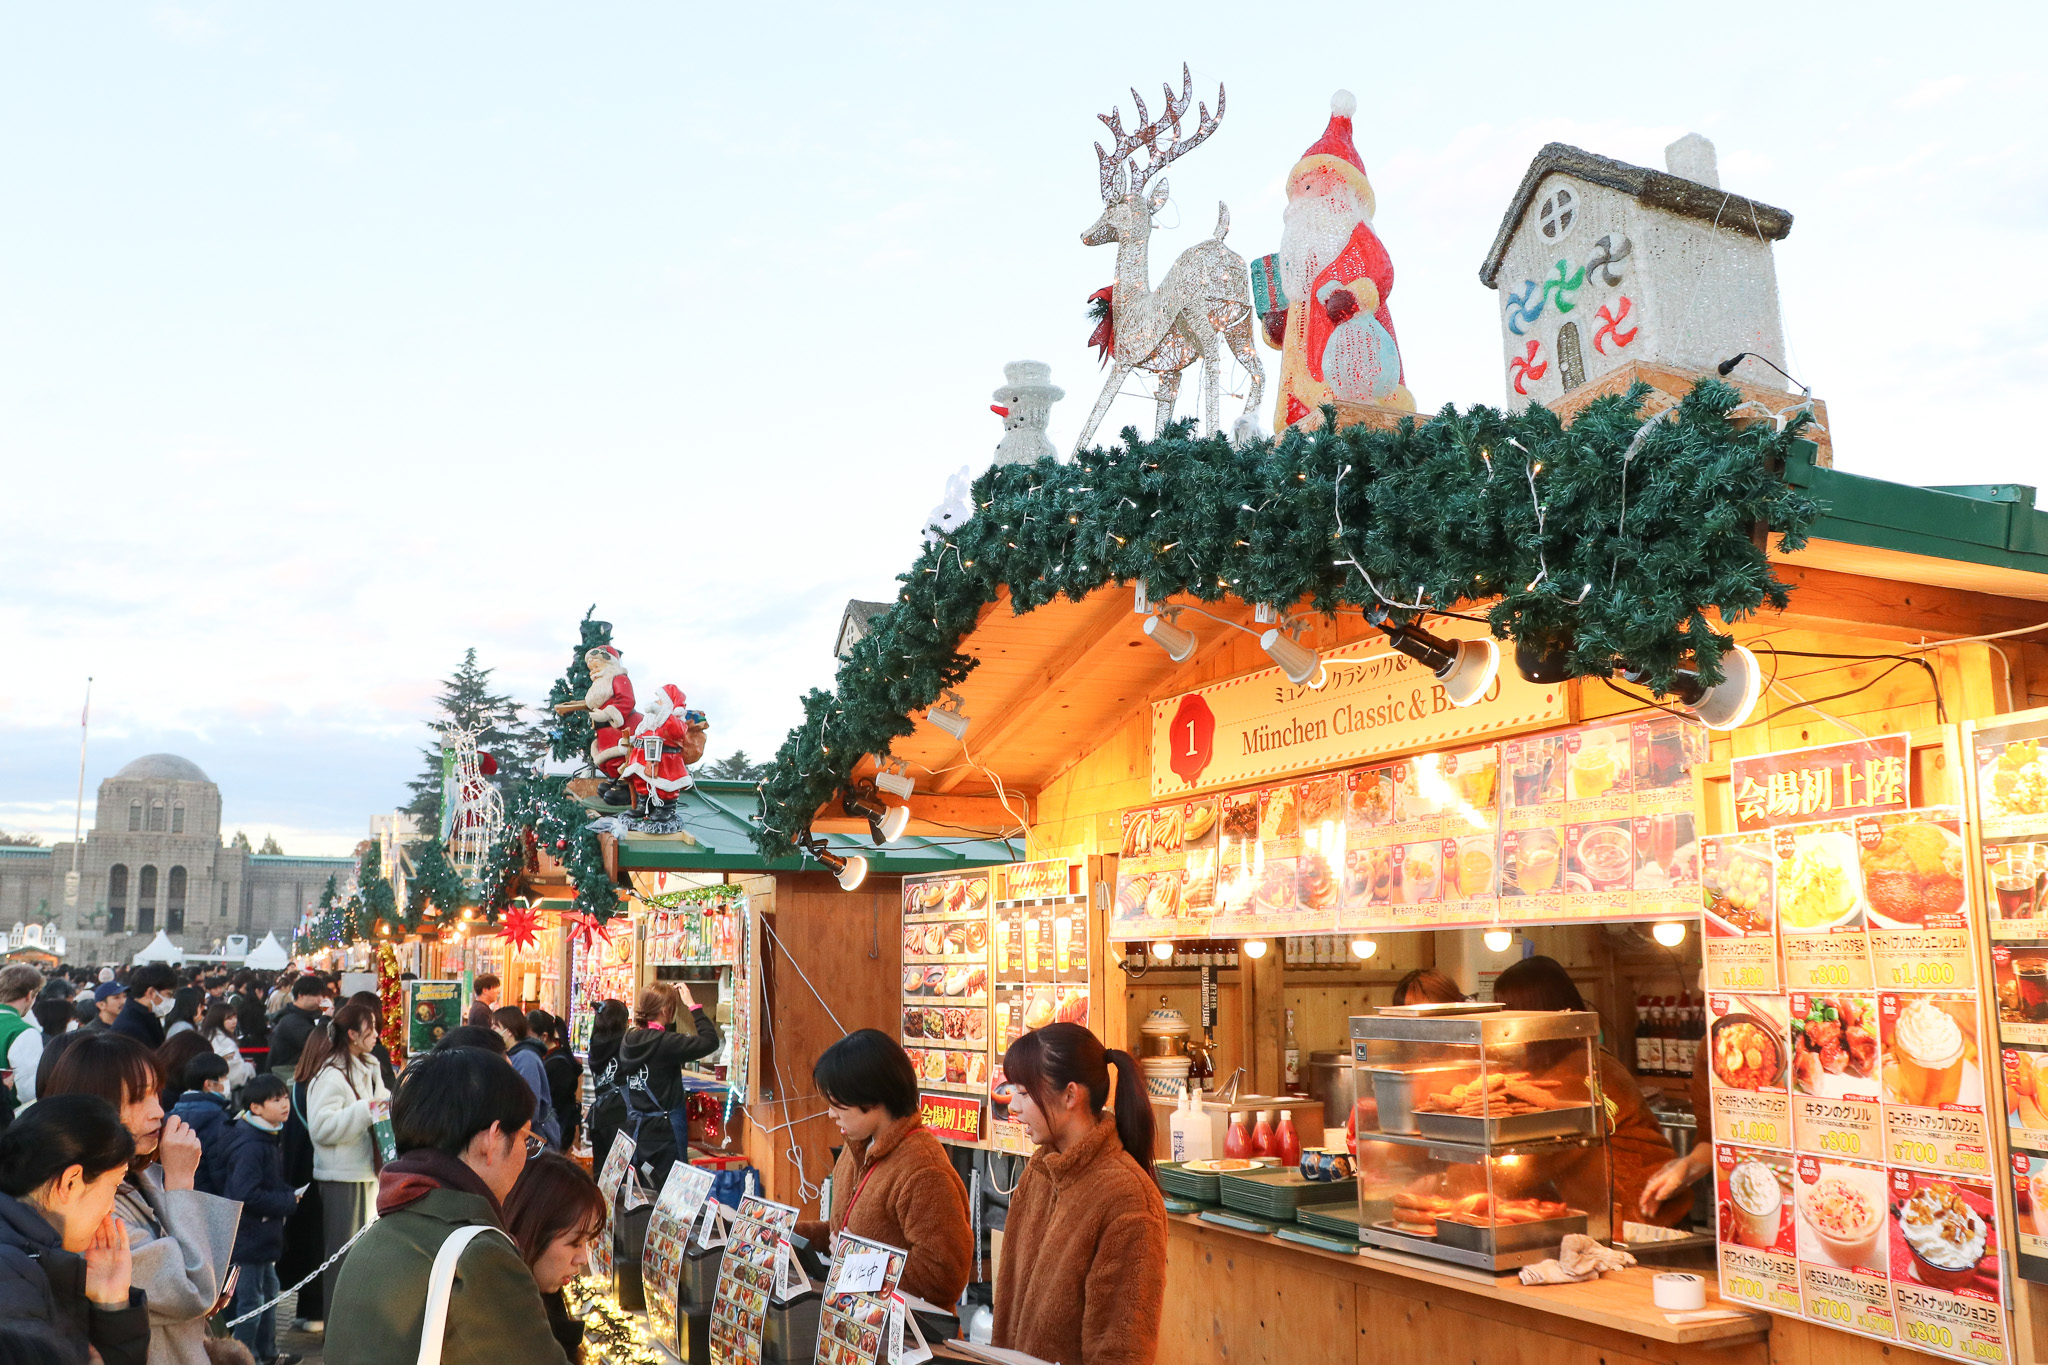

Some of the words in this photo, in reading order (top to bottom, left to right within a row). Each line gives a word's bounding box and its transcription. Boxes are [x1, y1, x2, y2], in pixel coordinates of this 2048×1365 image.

[1242, 717, 1328, 756] München
[1332, 694, 1405, 736] Classic
[1408, 688, 1428, 722] &
[1184, 719, 1198, 757] 1
[1735, 755, 1905, 823] 会場初上陸
[1871, 936, 1966, 950] トマトパプリカのシュニッツェル
[1723, 966, 1764, 990] ¥1,300
[1810, 965, 1849, 984] ¥800
[1892, 962, 1954, 988] ¥1,000
[1884, 1006, 1897, 1014] 限定
[920, 1103, 978, 1134] 会場初上陸
[1805, 1102, 1872, 1122] 牛タンのグリル
[1888, 1112, 1980, 1134] ローステッドアップルプンシュ
[1730, 1120, 1778, 1144] ¥1,000
[1820, 1130, 1860, 1154] ¥800
[1894, 1140, 1938, 1164] ¥700
[1944, 1152, 1986, 1170] ¥1,700
[1801, 1168, 1818, 1177] 100%
[1895, 1181, 1910, 1191] 限定
[1723, 1249, 1796, 1276] ホワイトホットショコラ
[1728, 1276, 1764, 1300] ¥700
[1804, 1268, 1888, 1298] いちごミルクのホットショコラ
[1768, 1290, 1800, 1308] ¥1,700
[1812, 1296, 1851, 1322] ¥700
[1897, 1288, 1997, 1324] ローストナッツのショコラ
[1857, 1314, 1893, 1332] ¥1,700
[1906, 1320, 1953, 1348] ¥800
[1960, 1340, 2002, 1361] ¥1,800
